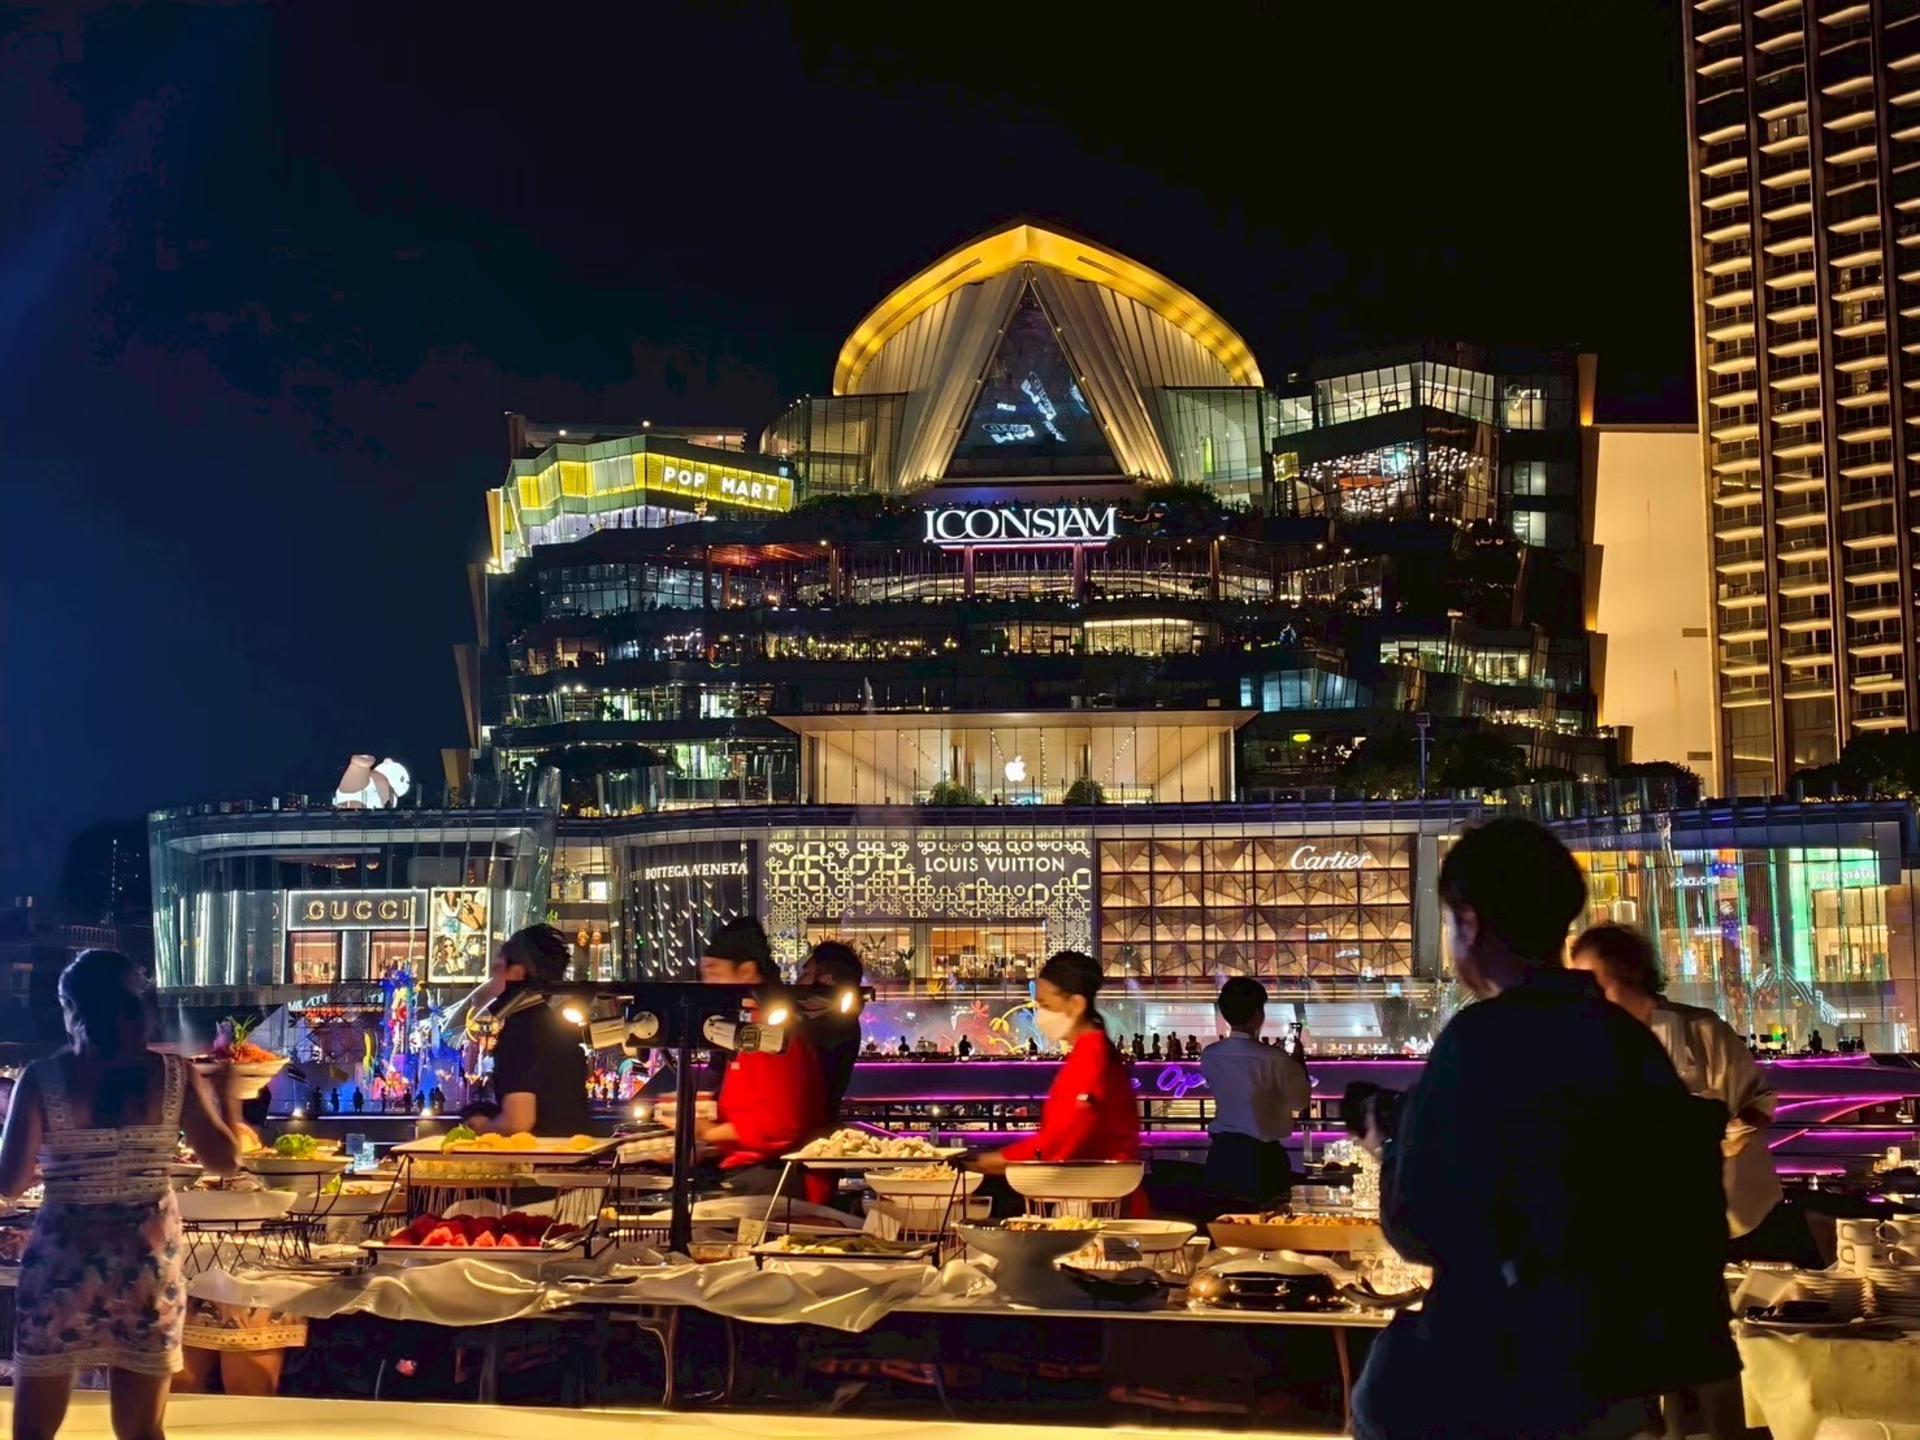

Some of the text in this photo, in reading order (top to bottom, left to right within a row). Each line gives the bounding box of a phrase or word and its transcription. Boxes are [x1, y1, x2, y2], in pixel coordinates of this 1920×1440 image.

[664, 466, 777, 501] POP MART
[923, 507, 1118, 542] ICONSIAM
[925, 857, 1065, 872] LOUIS VUITTON
[1291, 845, 1372, 870] Cartier
[645, 863, 748, 880] BOTTEGA VENETA
[306, 900, 409, 920] GUCCI
